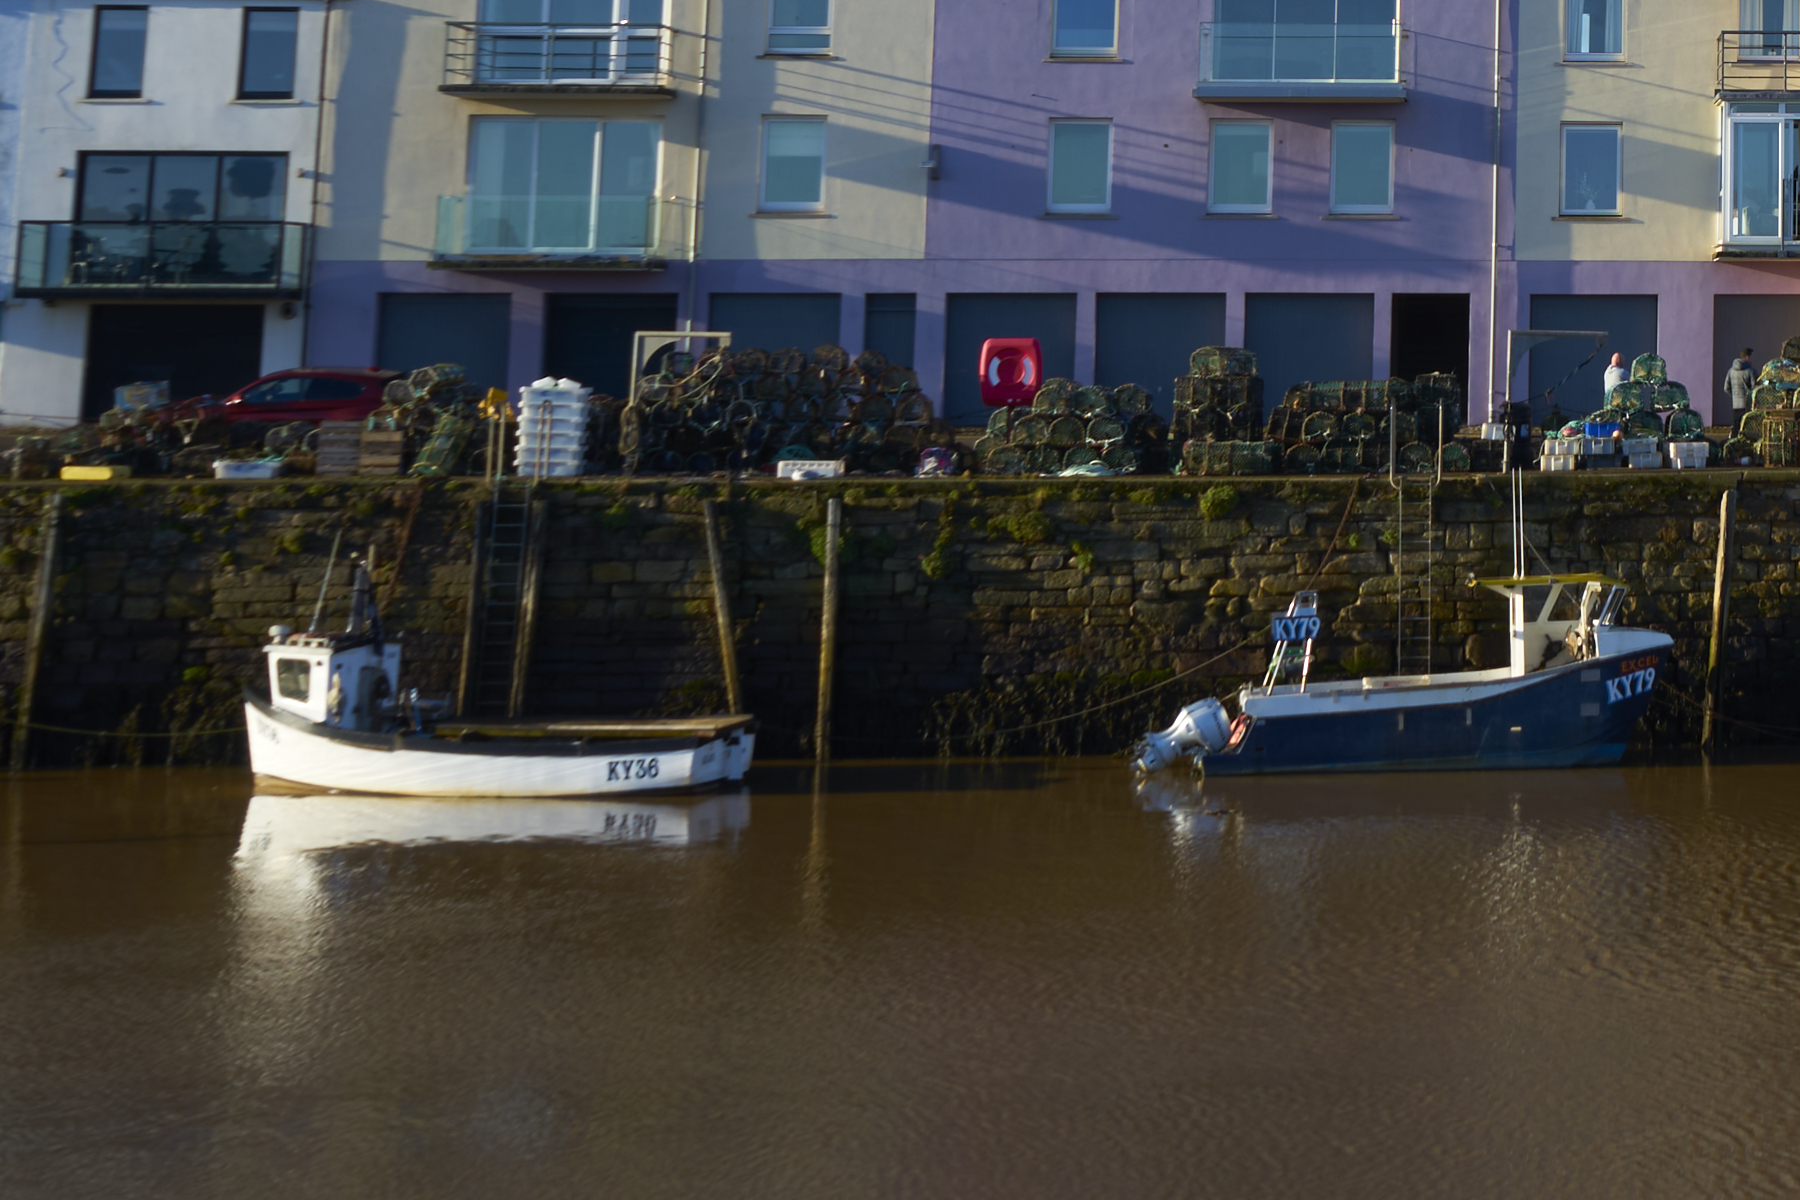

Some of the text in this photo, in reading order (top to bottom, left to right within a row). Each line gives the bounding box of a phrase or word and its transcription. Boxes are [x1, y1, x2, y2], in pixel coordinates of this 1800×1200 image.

[1274, 616, 1320, 640] KY79
[1620, 655, 1659, 674] EXCEL
[1605, 667, 1656, 705] KY79
[606, 758, 660, 781] KY36
